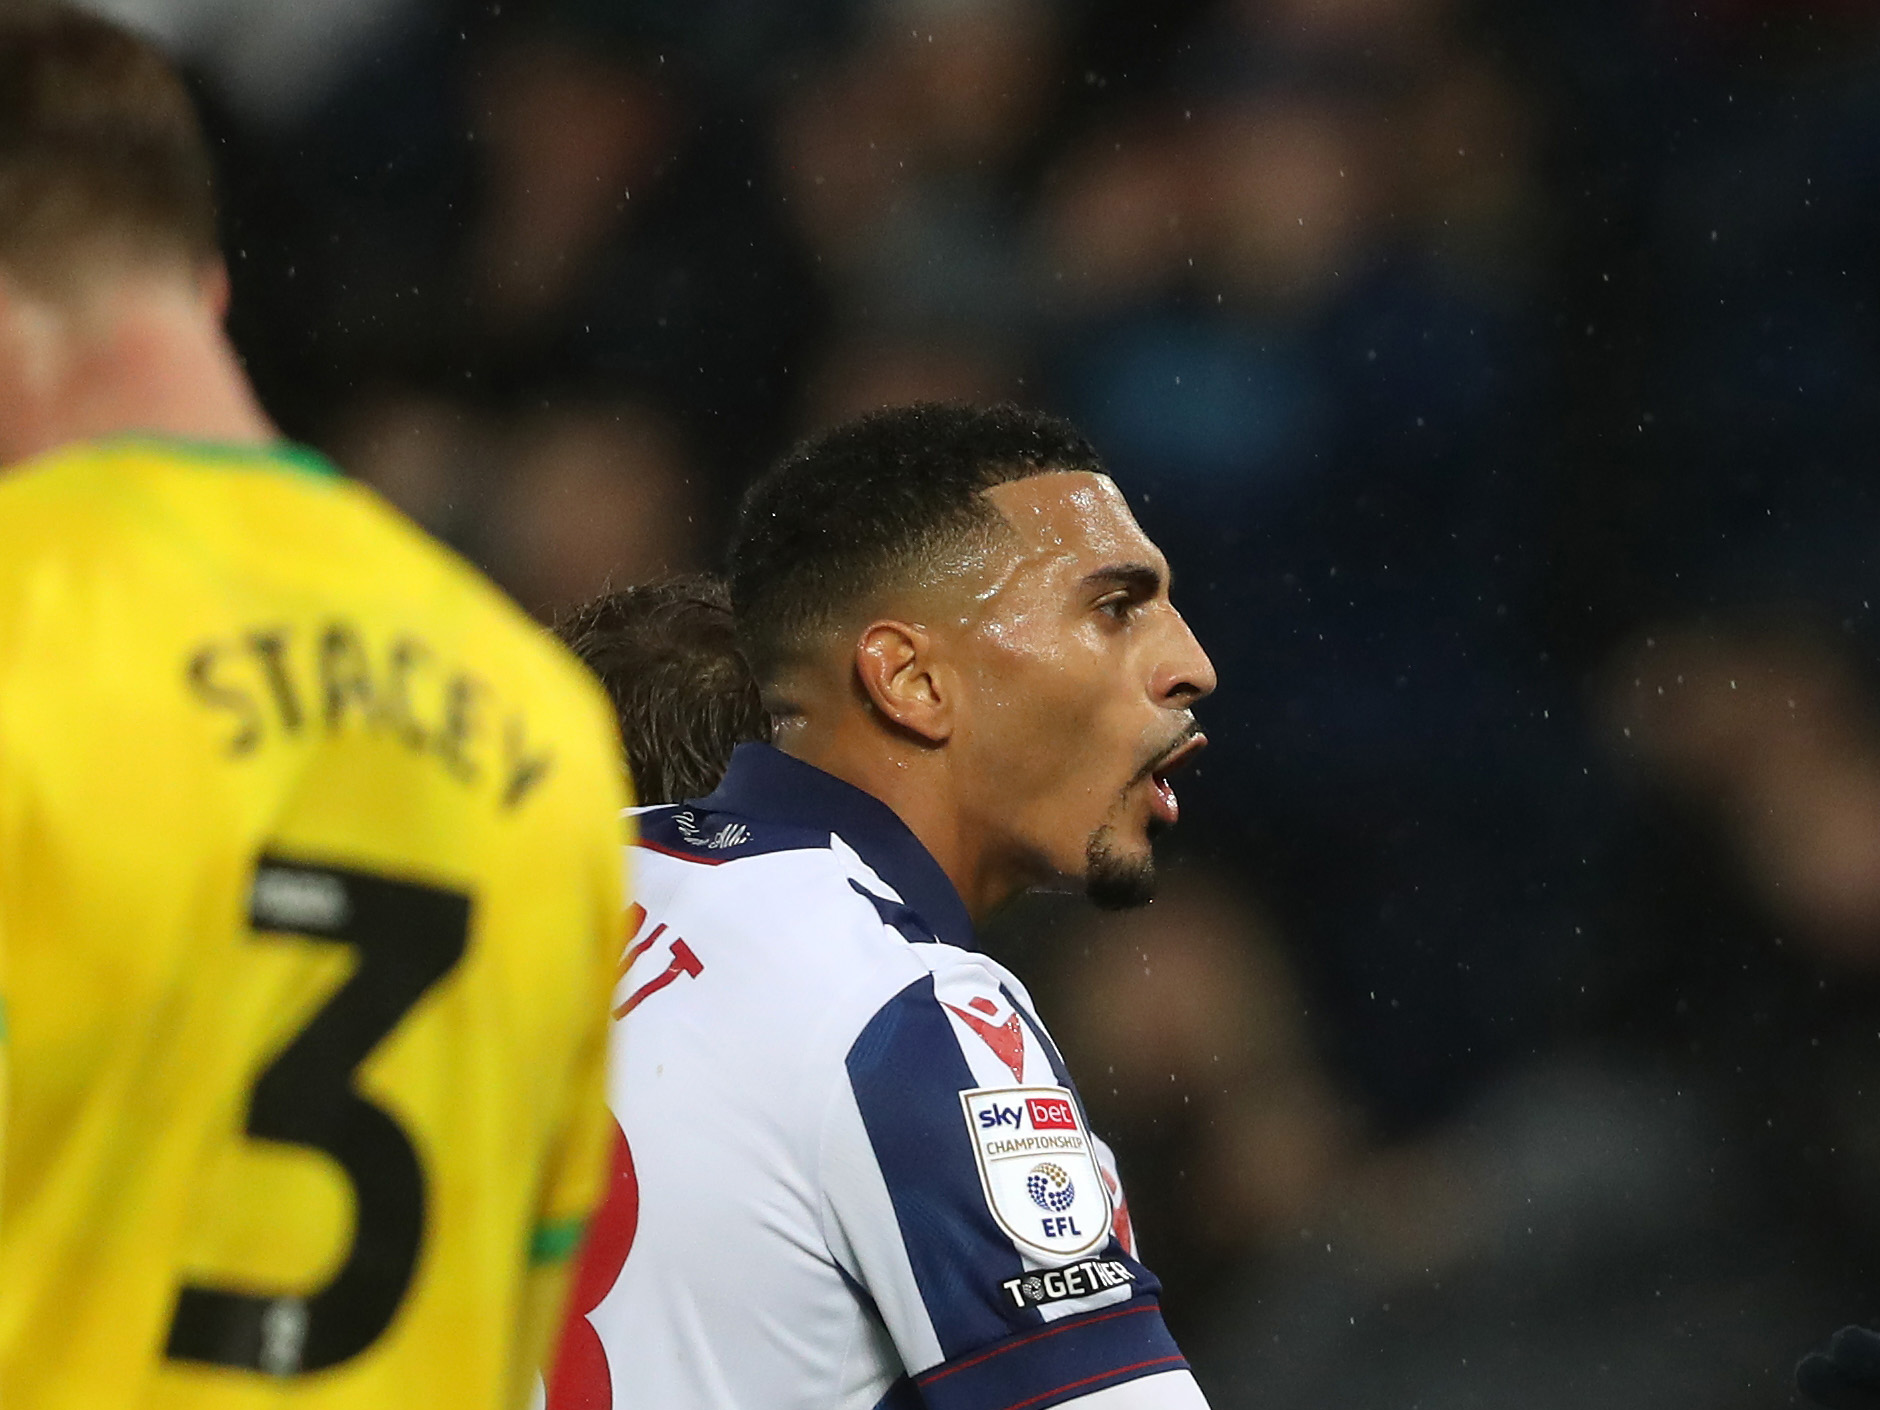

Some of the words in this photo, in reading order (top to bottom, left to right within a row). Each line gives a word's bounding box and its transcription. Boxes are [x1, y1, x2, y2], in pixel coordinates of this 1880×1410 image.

[185, 616, 556, 810] STACEY
[160, 843, 477, 1385] 3
[979, 1104, 1023, 1130] sky
[1031, 1102, 1073, 1124] bet
[986, 1136, 1083, 1155] CHAMPIONSHIP
[1042, 1217, 1082, 1239] EFL
